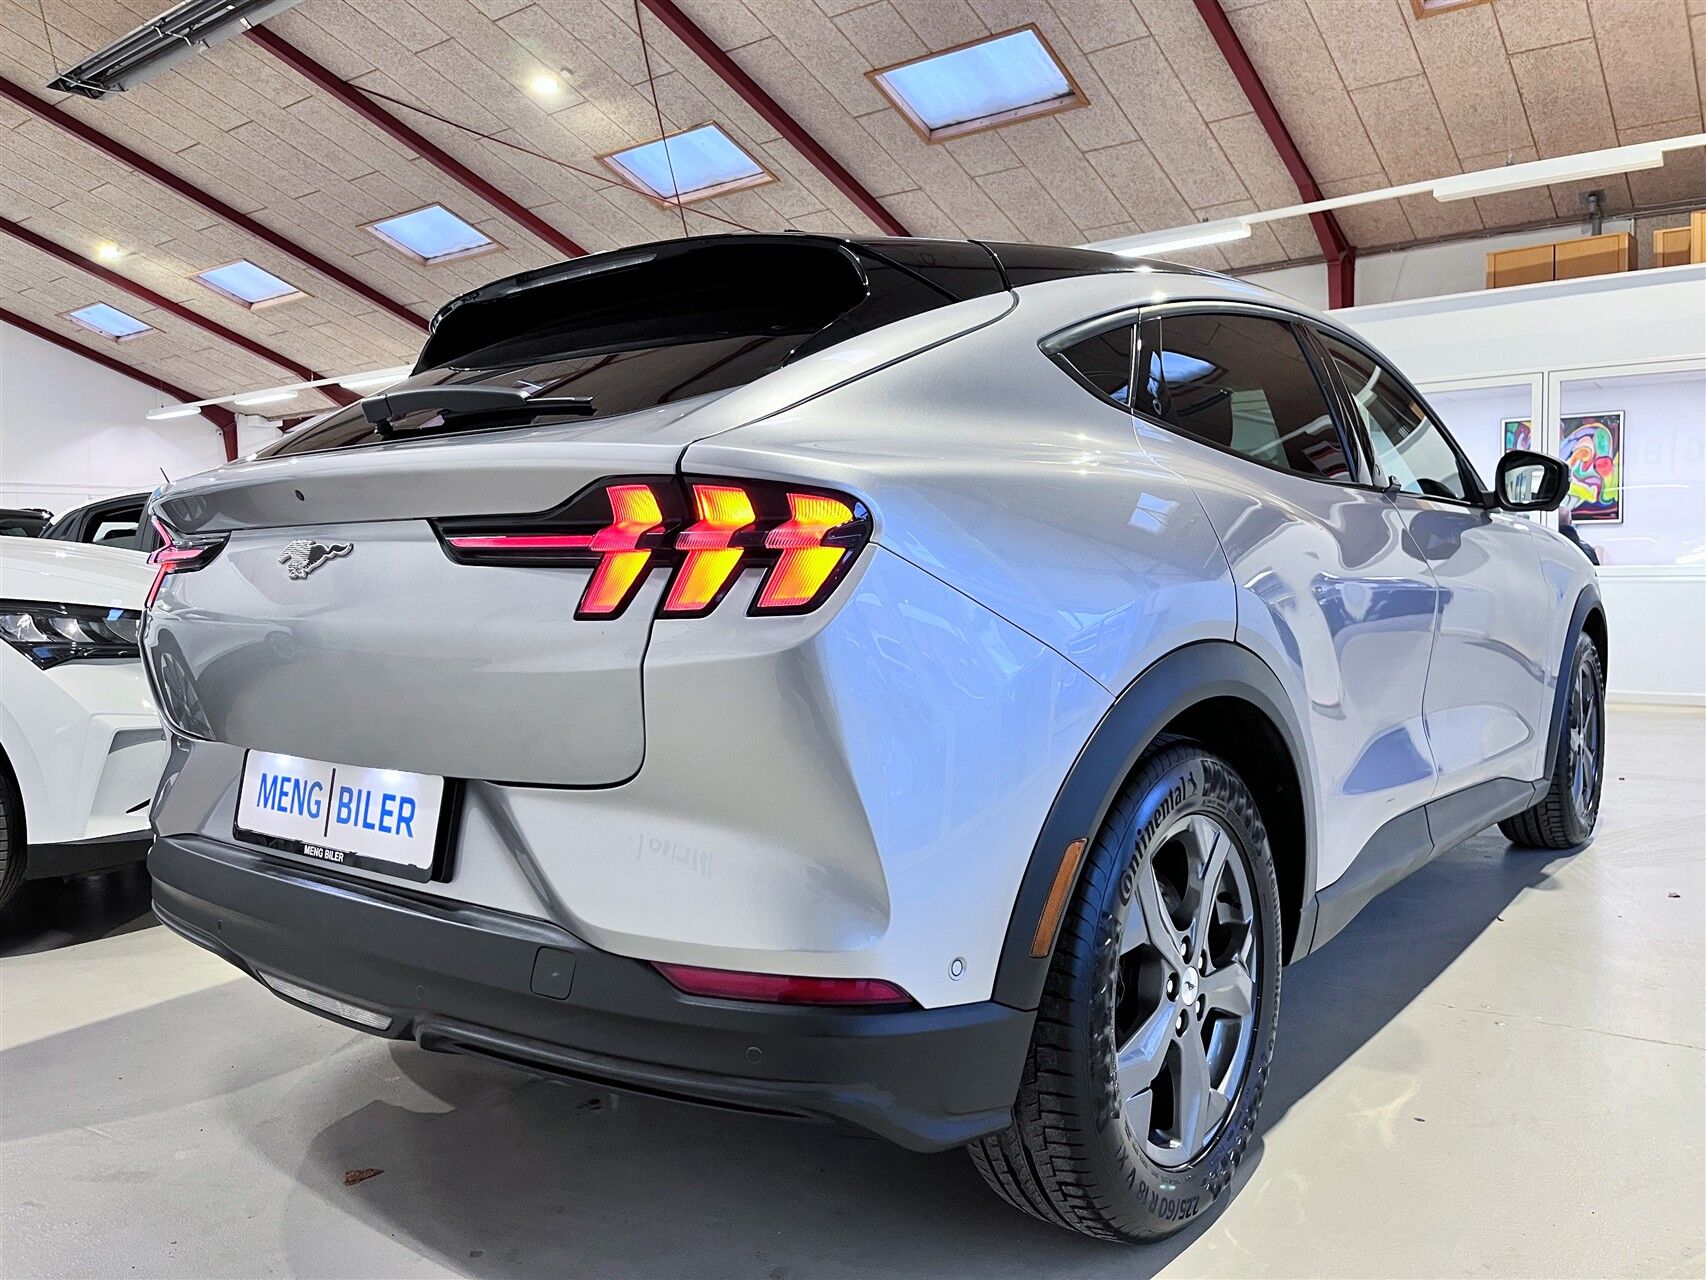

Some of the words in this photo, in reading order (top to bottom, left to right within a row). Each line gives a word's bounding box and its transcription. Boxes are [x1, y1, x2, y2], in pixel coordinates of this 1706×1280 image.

[257, 773, 323, 819] MENG
[336, 786, 416, 838] BILER
[303, 844, 324, 858] MENG
[324, 849, 344, 862] BILER
[1120, 776, 1186, 906] Continental
[1158, 1195, 1200, 1222] 225/60
